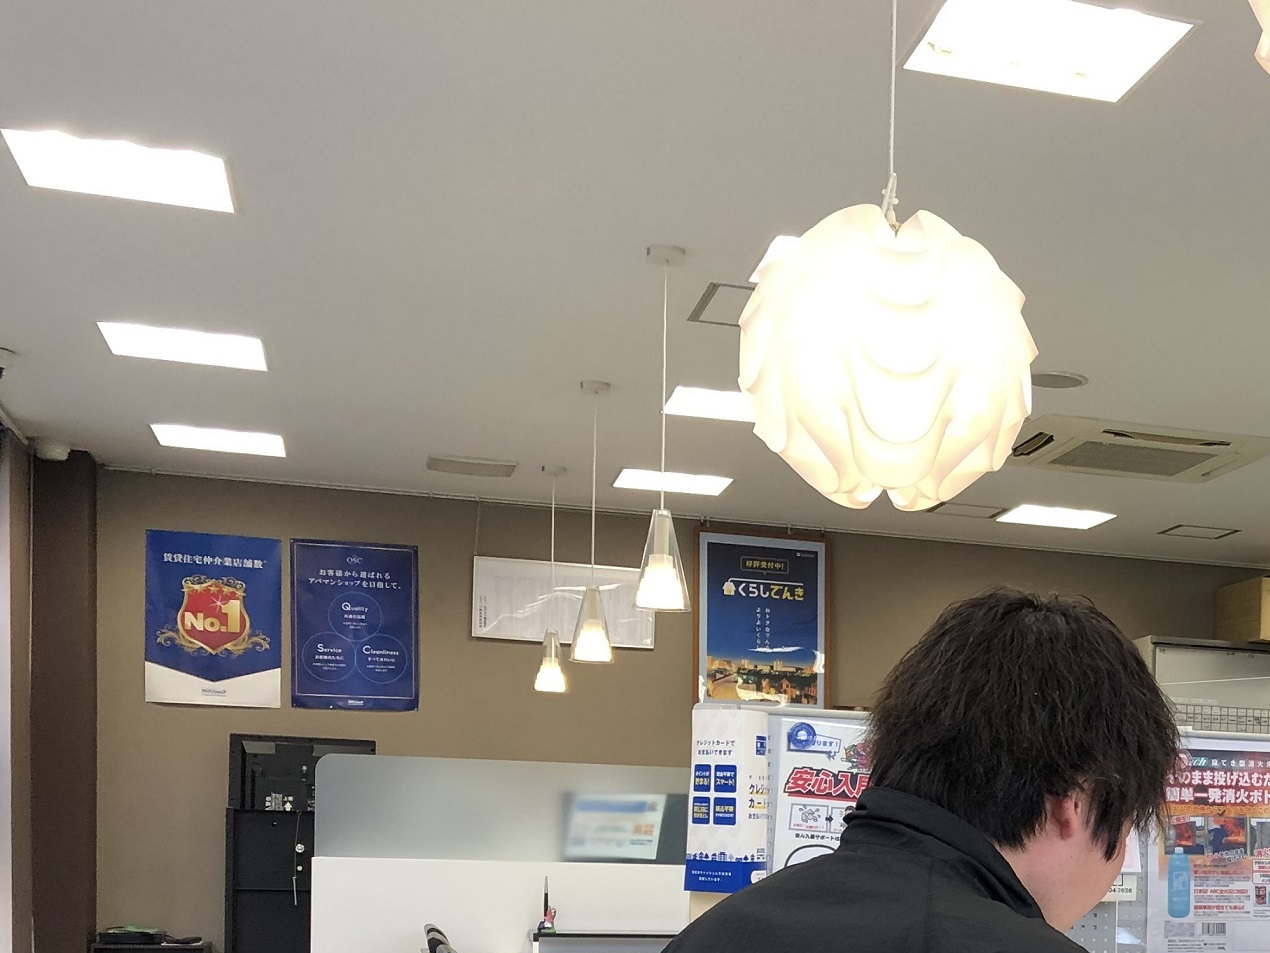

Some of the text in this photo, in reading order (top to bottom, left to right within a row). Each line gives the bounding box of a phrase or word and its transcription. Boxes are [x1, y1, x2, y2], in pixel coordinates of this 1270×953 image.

[163, 552, 264, 569] 賃貸住宅仲介業店舗数
[738, 583, 804, 601] くらしでんき
[184, 600, 240, 633] No.1
